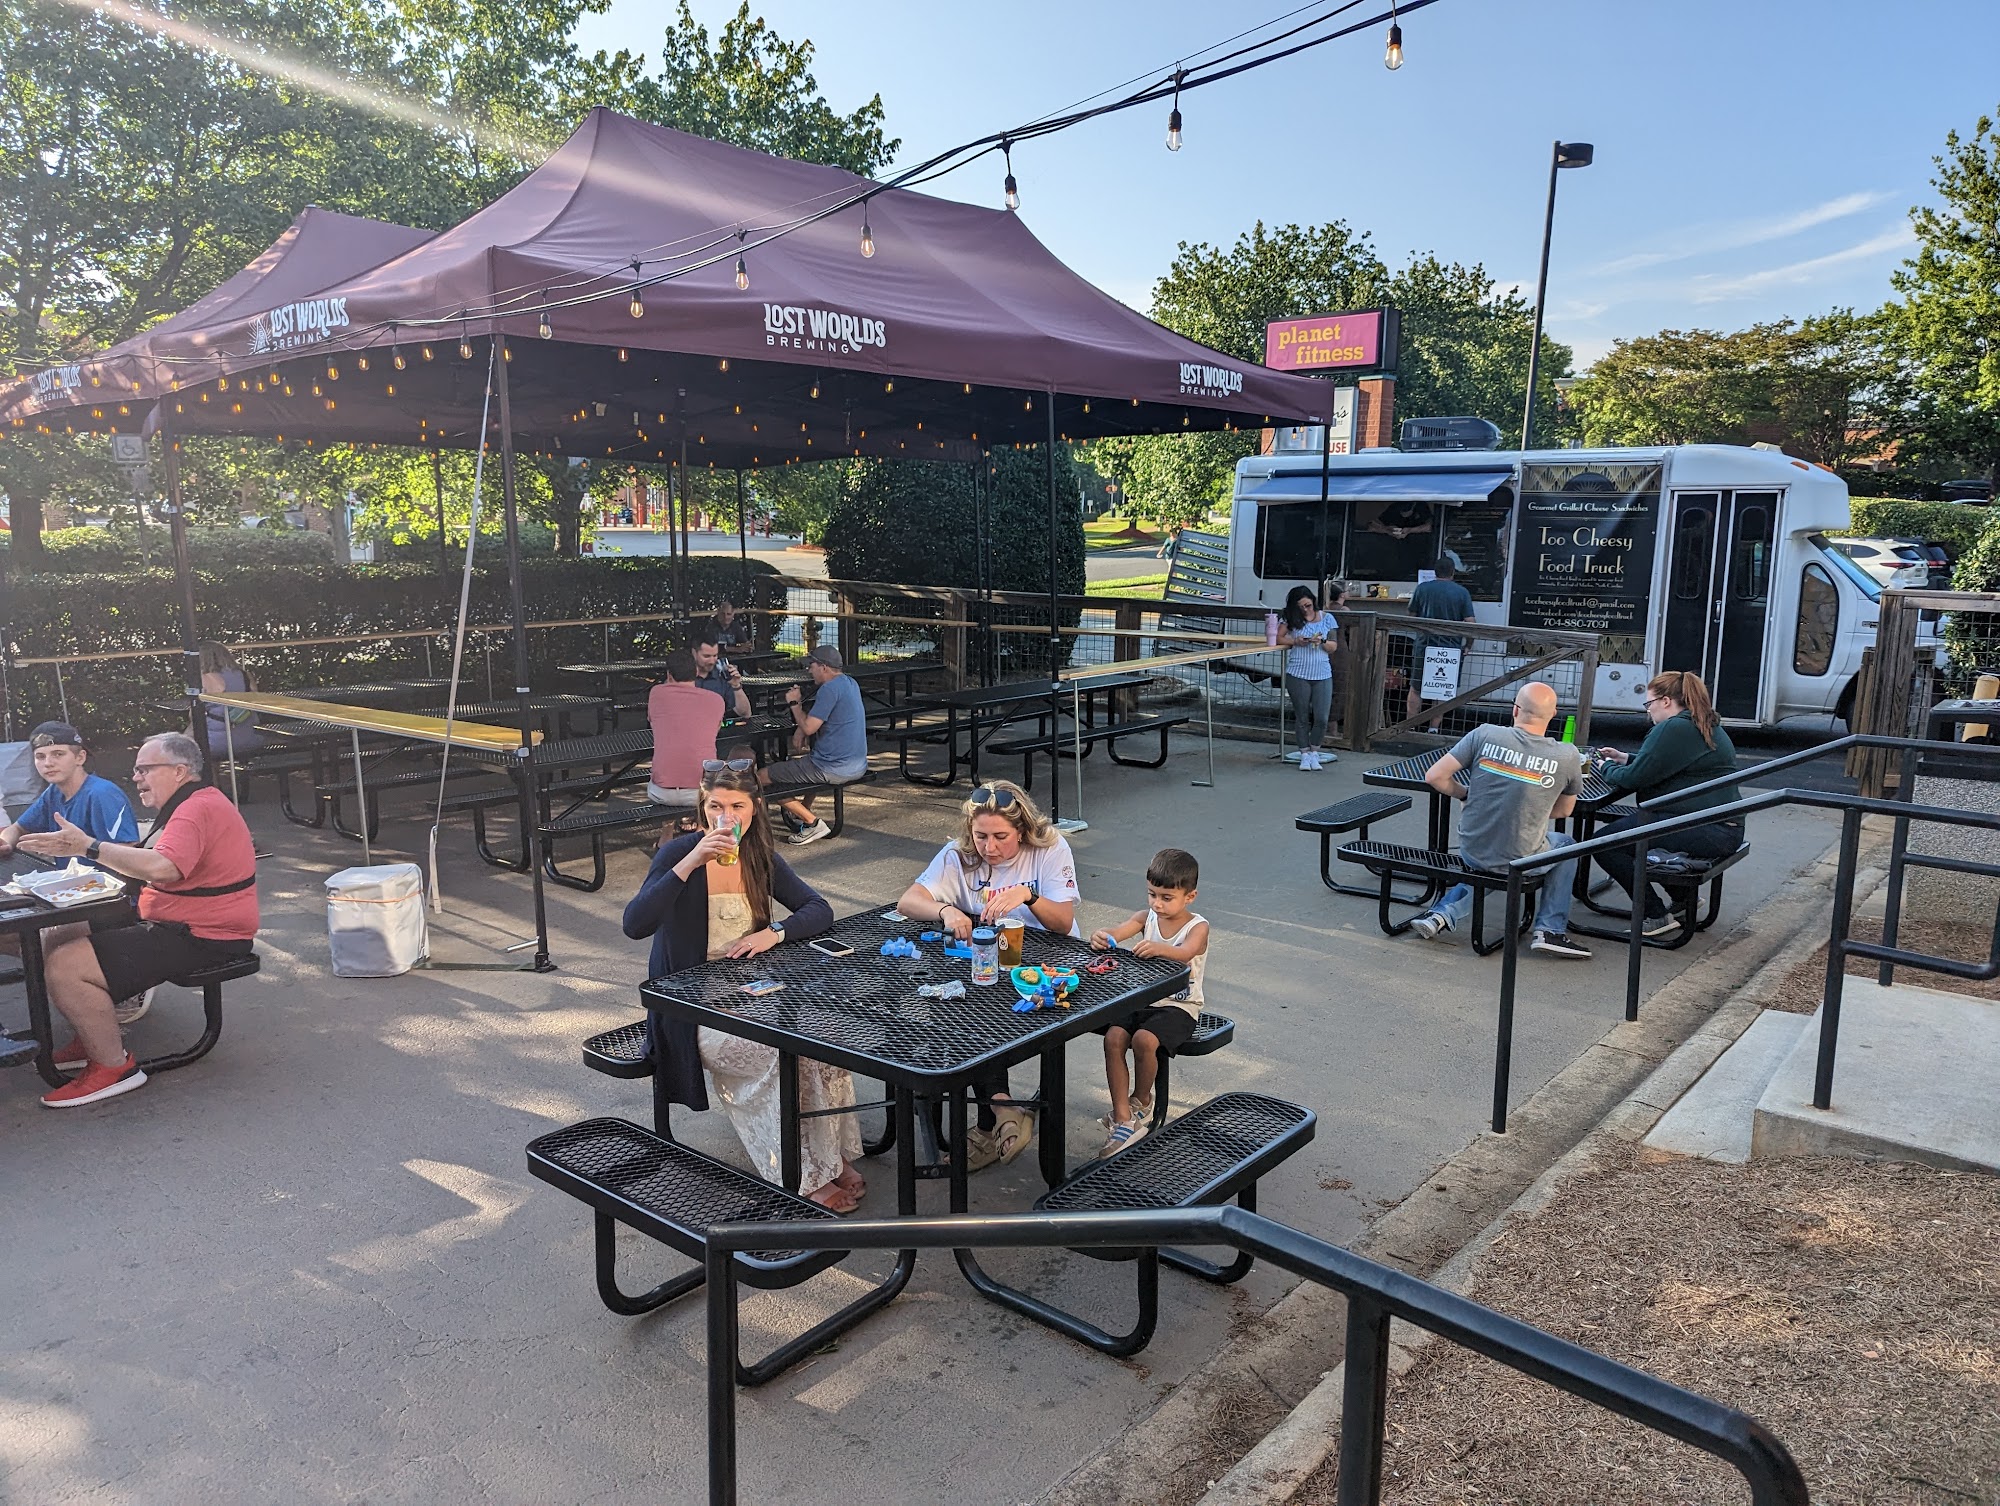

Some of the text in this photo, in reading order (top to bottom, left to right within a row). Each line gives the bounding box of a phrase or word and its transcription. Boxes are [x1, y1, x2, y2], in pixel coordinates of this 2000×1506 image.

[270, 297, 350, 338] LOST WORLDS
[763, 303, 886, 352] LOST WORLDS
[272, 332, 322, 351] BREWING
[766, 335, 849, 354] BREWING
[1278, 323, 1341, 349] planet
[1295, 345, 1364, 365] fitness
[37, 369, 52, 393] LOST
[1179, 362, 1243, 397] LOST WORLDS
[1180, 385, 1223, 399] BREWING
[1329, 442, 1347, 453] USE
[1528, 502, 1648, 512] Gourmet Grilled Cheese Sandwiches
[1538, 526, 1633, 551] Too Cheesy
[1539, 553, 1624, 574] Food Truck
[1543, 618, 1609, 629] 704-880-7091
[1426, 657, 1458, 665] SMOKING
[1424, 682, 1455, 690] ALLOWED
[1481, 743, 1559, 775] HILTON HEAD
